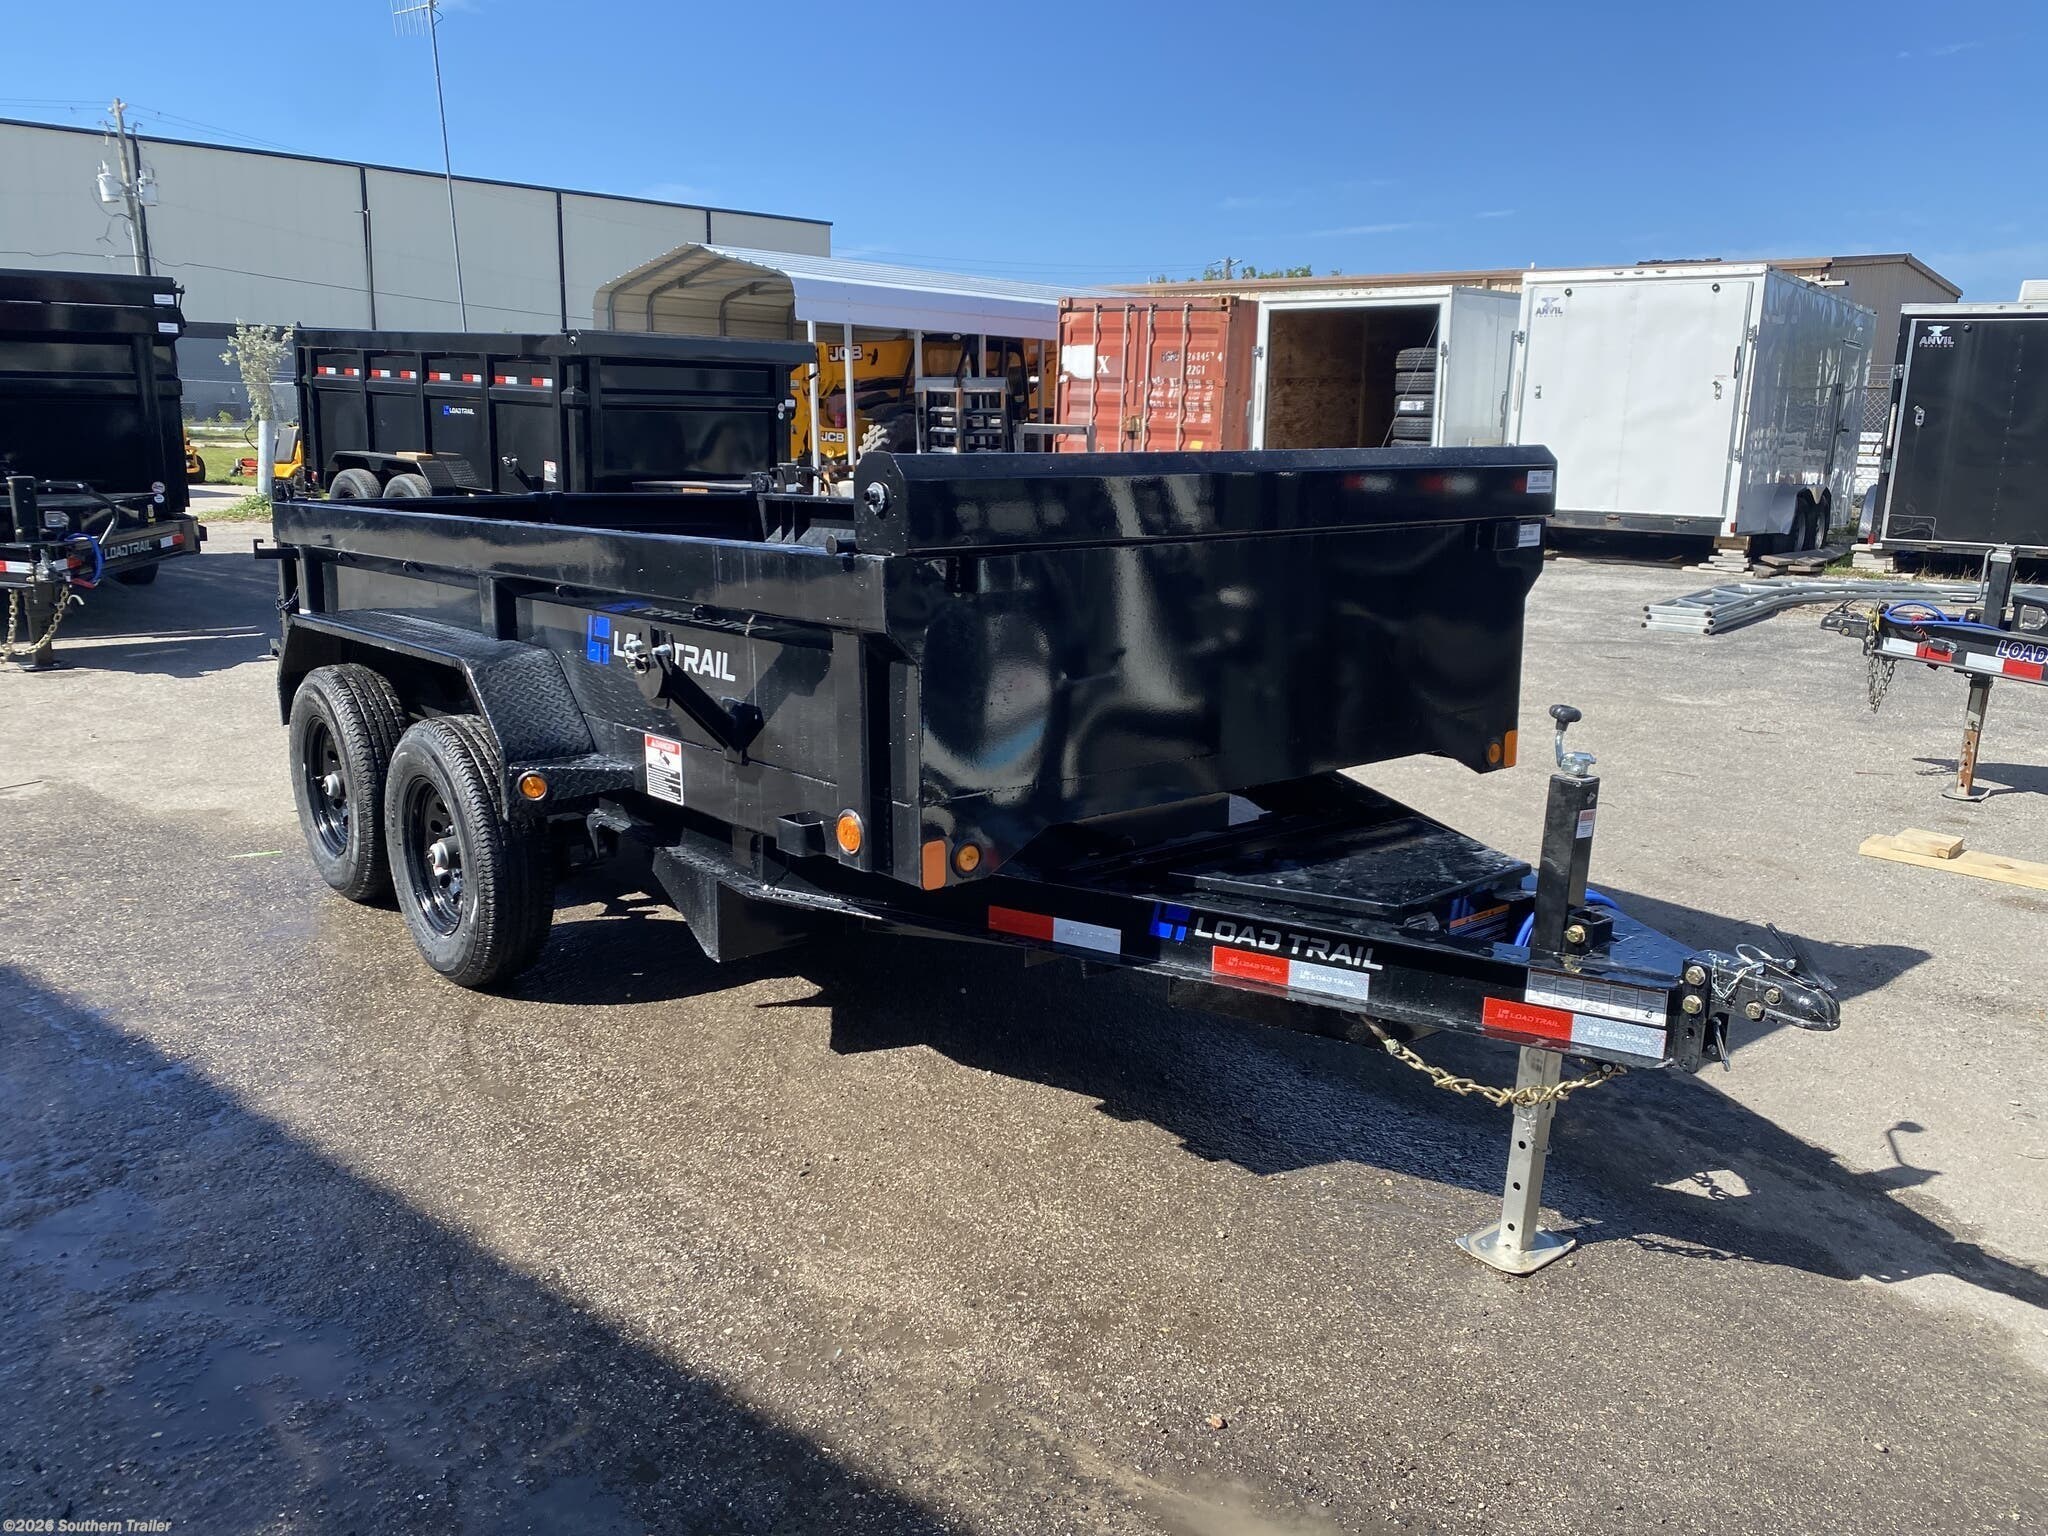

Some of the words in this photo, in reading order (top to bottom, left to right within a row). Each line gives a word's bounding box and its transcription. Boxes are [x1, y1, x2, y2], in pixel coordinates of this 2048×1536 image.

[1919, 336, 1955, 345] ANVIL
[1096, 355, 1111, 374] X
[821, 432, 845, 443] JCB
[104, 545, 129, 561] LOAD
[128, 540, 153, 555] TRAIL
[1995, 640, 2048, 665] LOAD
[673, 642, 736, 682] TRAIL
[1194, 916, 1282, 951] LOAD
[1288, 932, 1384, 971] TRAIL
[1238, 960, 1260, 970] LOAD
[1260, 964, 1283, 974] TRAIL
[1311, 974, 1333, 983] LOAD
[1510, 1012, 1535, 1023] LOAD
[1535, 1017, 1561, 1028] TRAIL
[1599, 1031, 1626, 1041] LOAD
